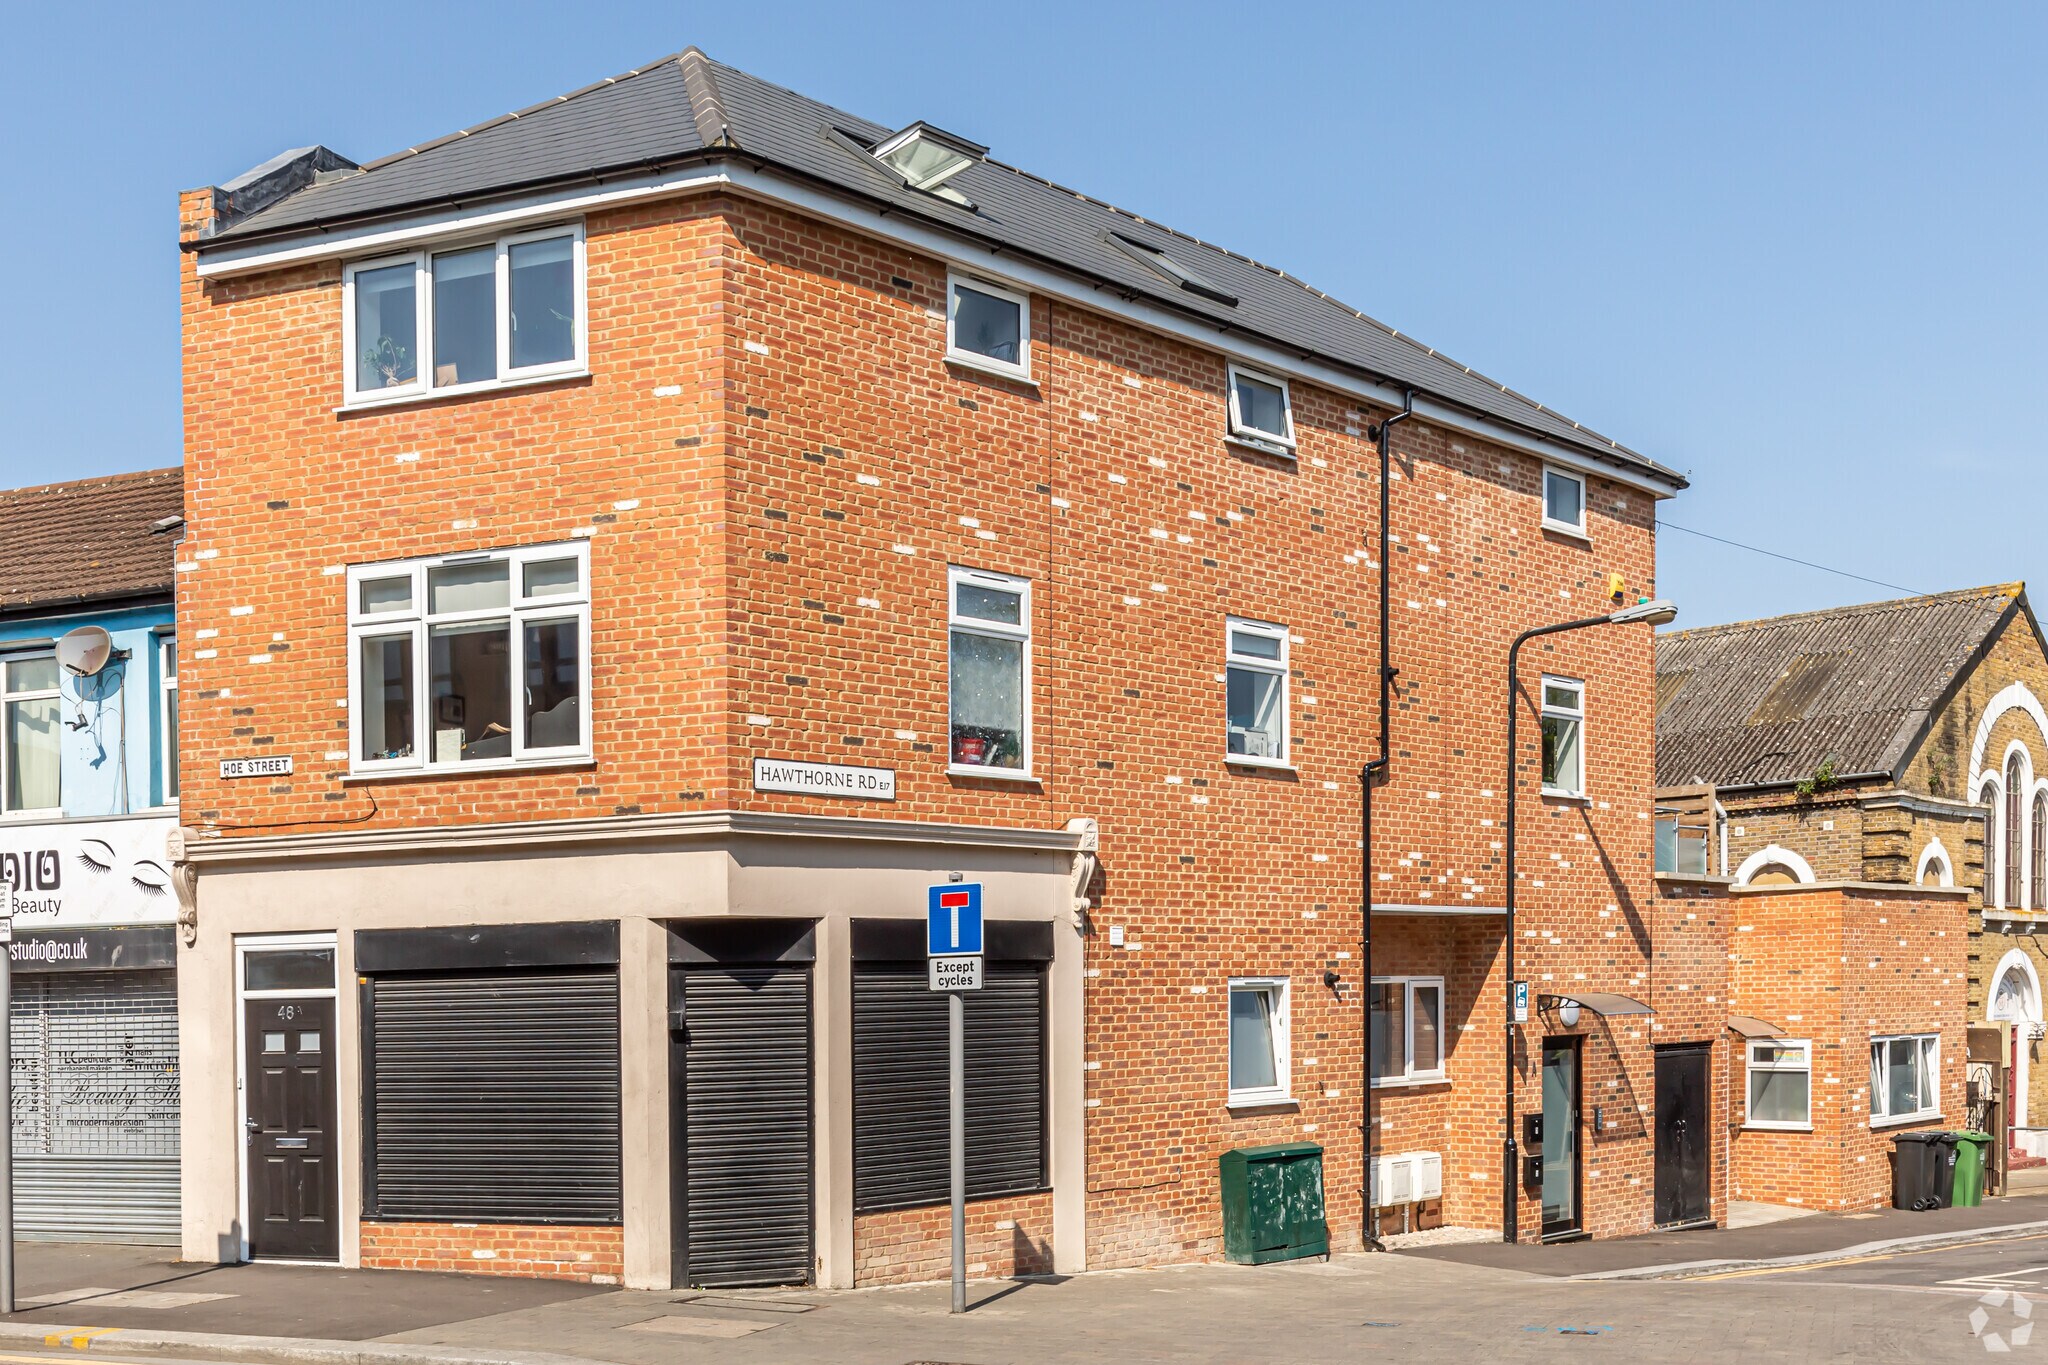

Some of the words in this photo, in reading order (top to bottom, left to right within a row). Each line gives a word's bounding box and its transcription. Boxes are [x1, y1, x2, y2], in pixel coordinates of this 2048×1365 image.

[223, 762, 243, 775] HOE
[248, 759, 288, 773] STREET
[760, 766, 853, 788] HAWTHORNE
[858, 775, 877, 790] RD
[13, 897, 62, 917] Beauty
[936, 960, 975, 974] Except
[938, 974, 973, 988] cycles
[1517, 984, 1526, 997] P
